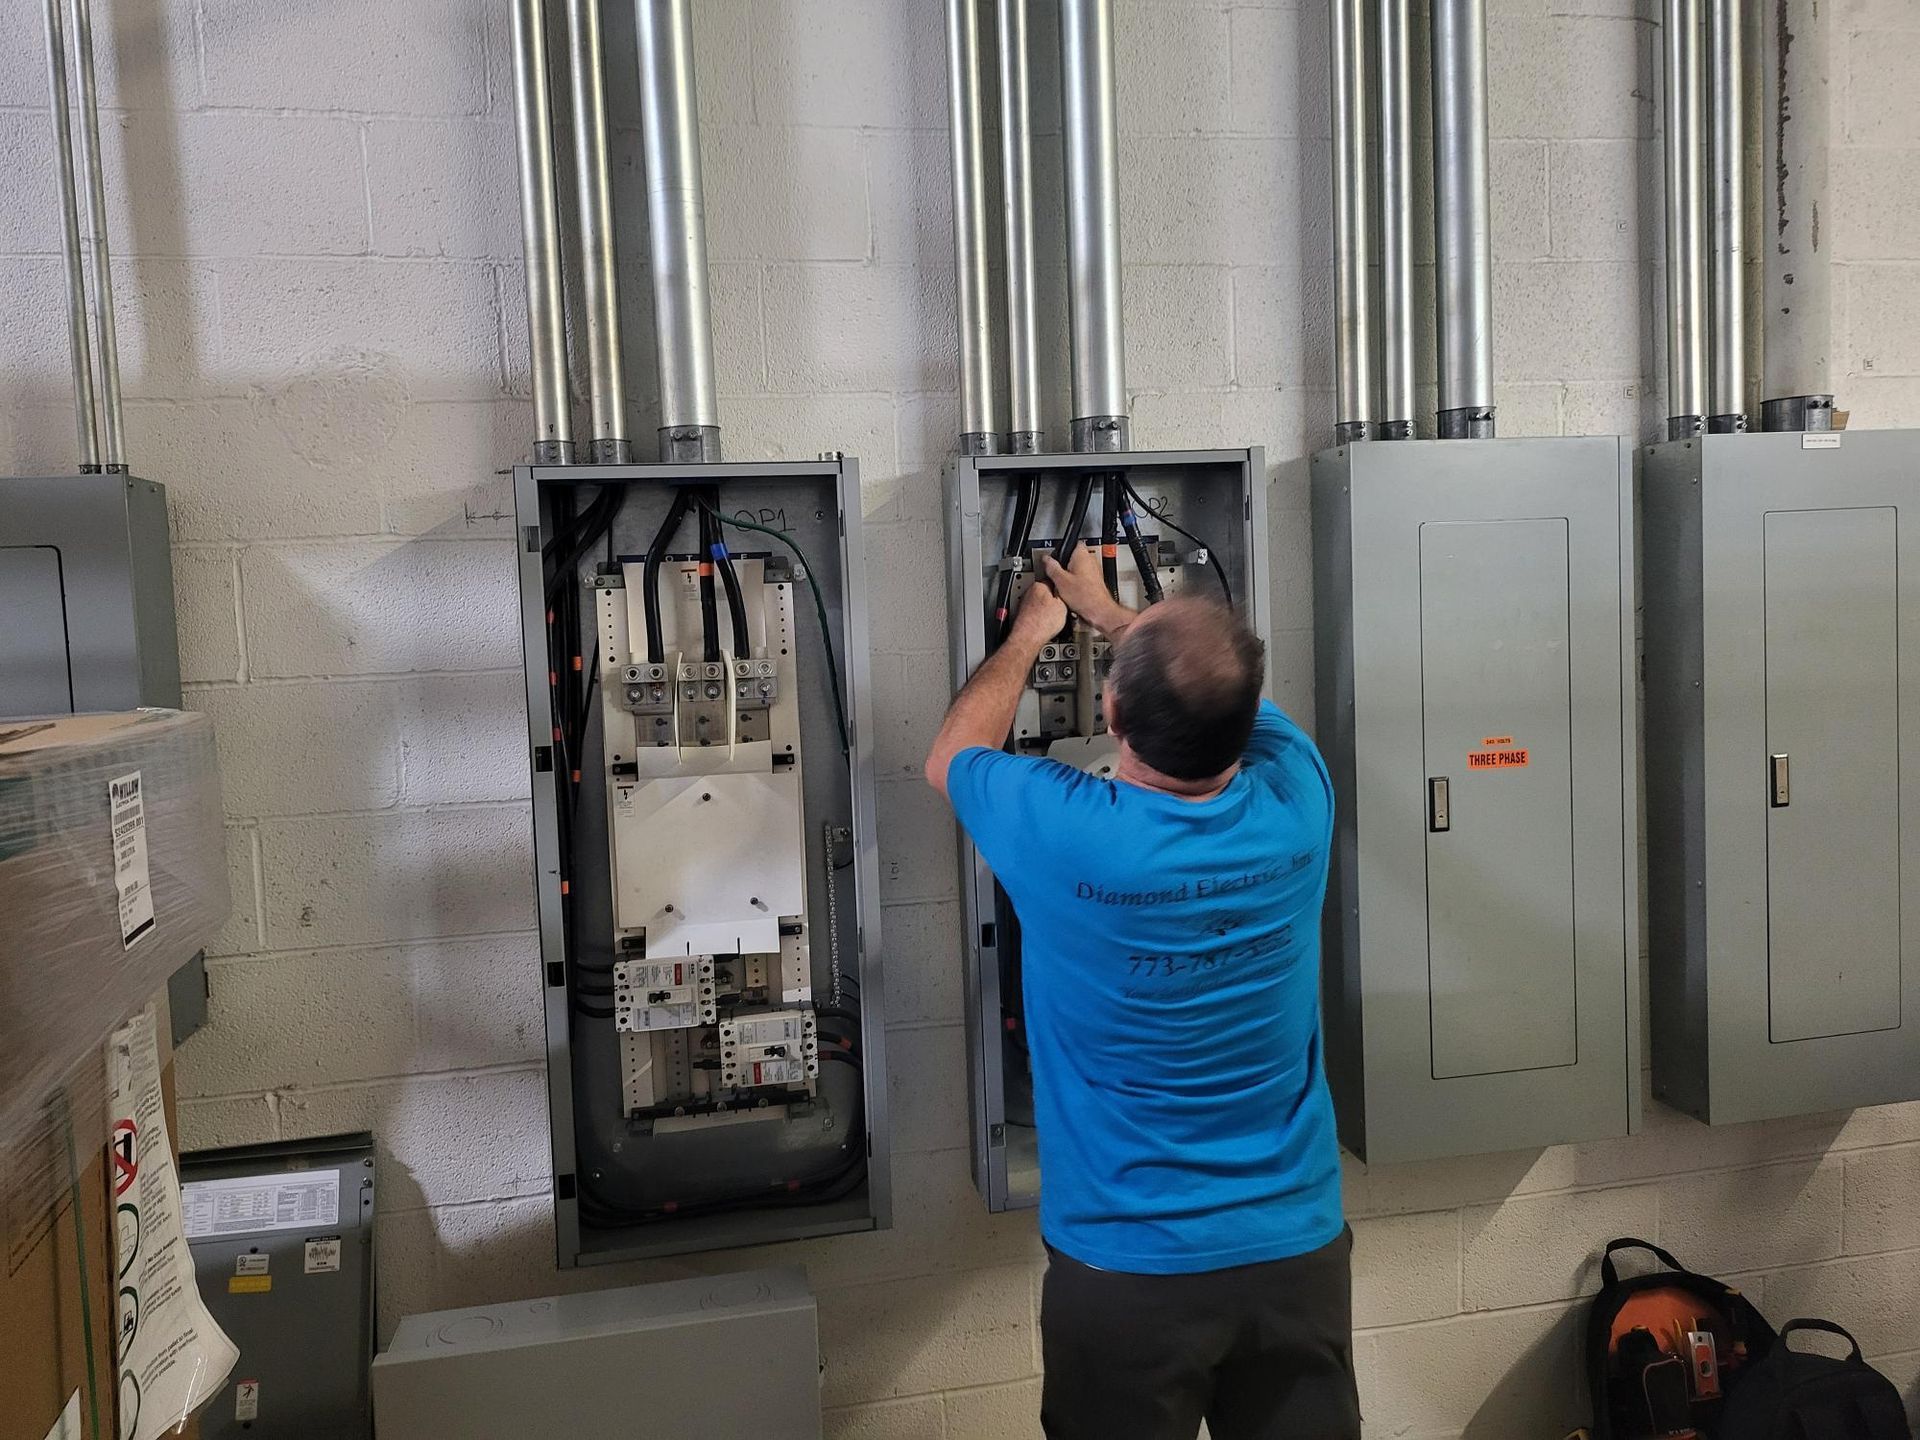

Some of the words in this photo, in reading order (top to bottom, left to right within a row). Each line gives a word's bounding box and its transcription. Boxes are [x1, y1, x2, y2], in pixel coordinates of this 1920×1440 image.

[1469, 753, 1497, 766] THREE
[1498, 751, 1526, 765] PHASE
[1076, 880, 1189, 907] Diamond
[1196, 863, 1283, 899] Electric
